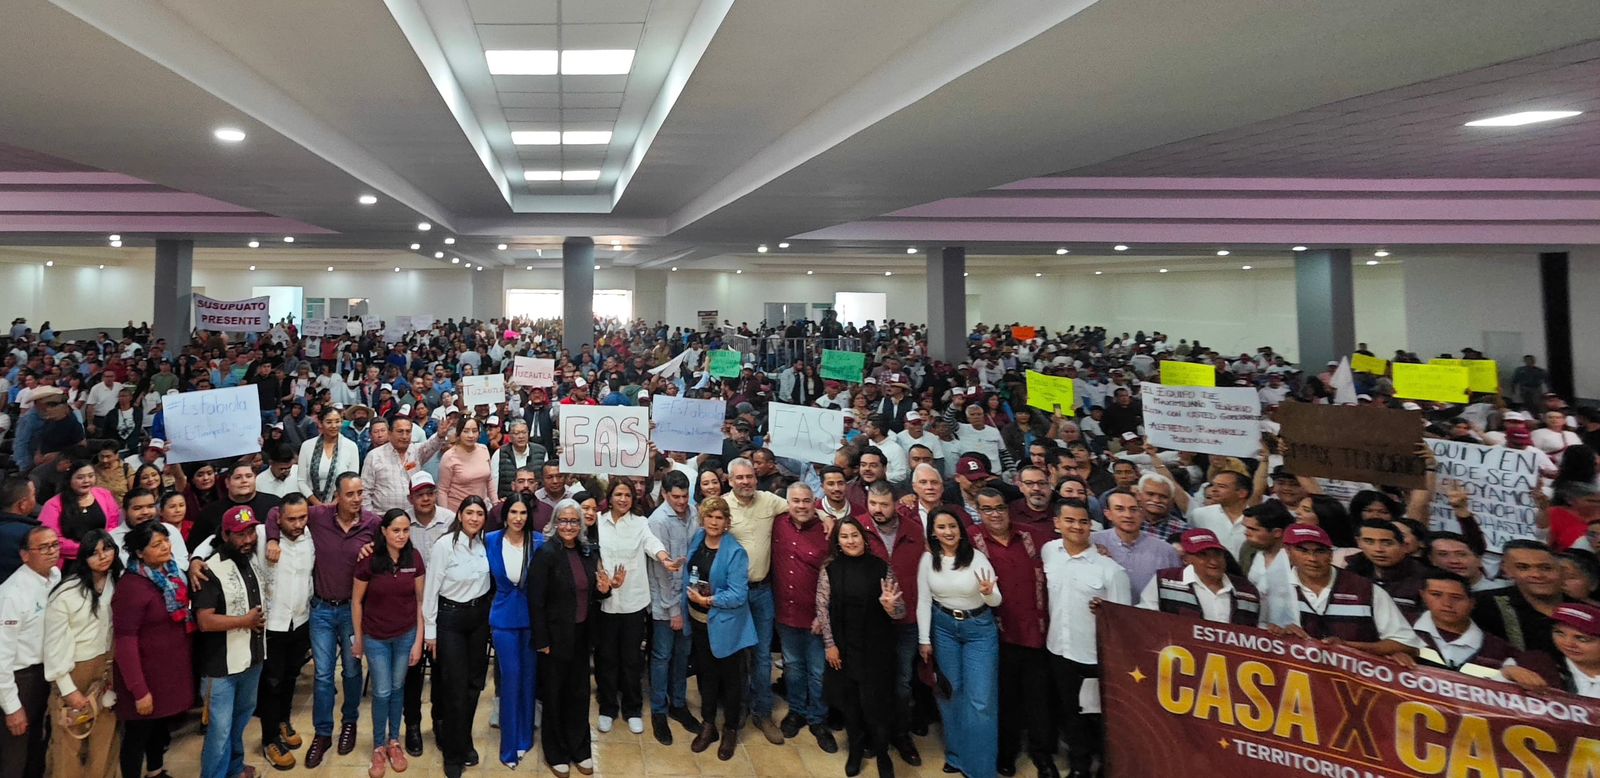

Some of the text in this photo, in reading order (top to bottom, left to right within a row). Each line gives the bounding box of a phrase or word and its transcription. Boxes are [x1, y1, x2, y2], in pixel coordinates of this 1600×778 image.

[197, 299, 266, 311] SUSUPUATO
[201, 314, 262, 325] PRESENTE
[564, 415, 649, 469] FAS
[774, 408, 836, 455] FAS
[967, 460, 979, 471] B
[1437, 461, 1533, 490] NDE SEA
[1478, 448, 1493, 464] Y
[1499, 450, 1537, 475] EN
[1470, 500, 1537, 525] ENORIO
[1192, 624, 1590, 725] ESTAMOS CONTIGO GOBERNADOR
[1156, 644, 1321, 746] CASA
[1327, 677, 1384, 761] X
[1232, 738, 1357, 778] TERRITORIO
